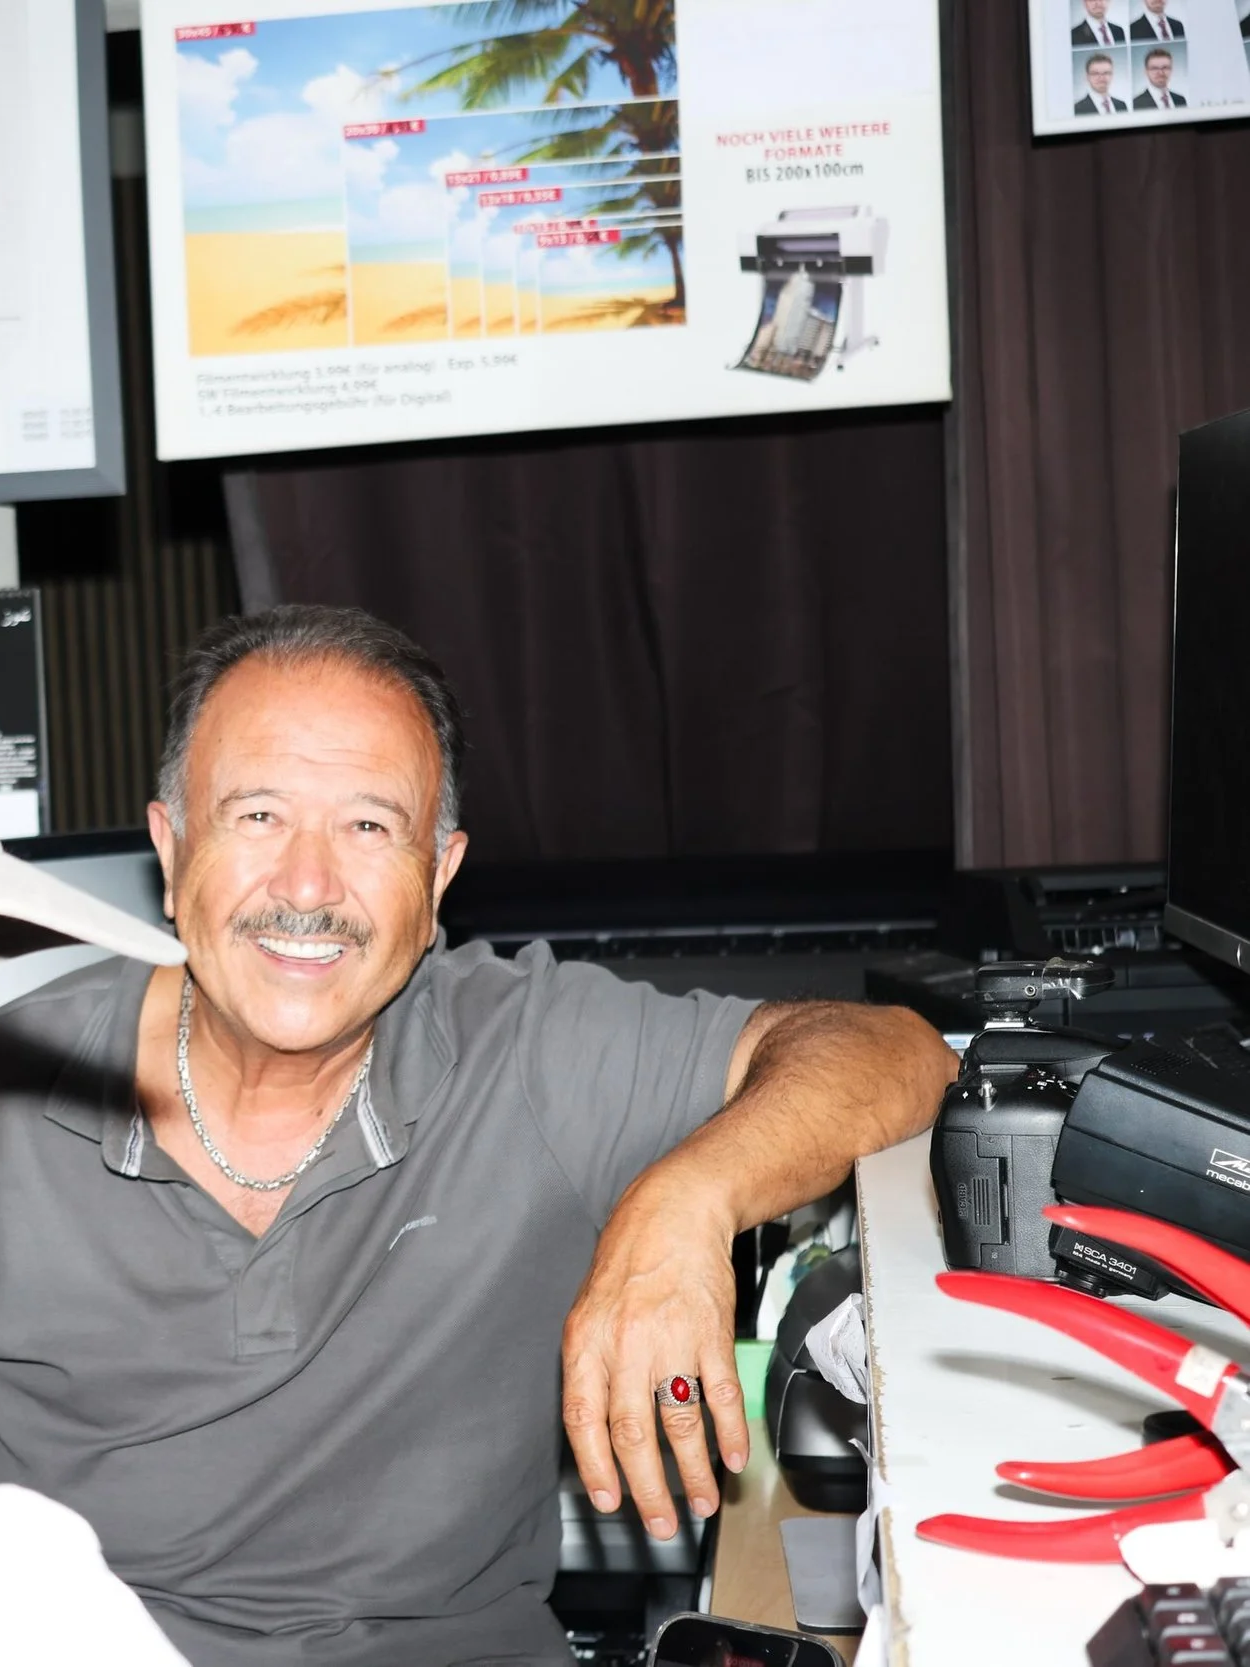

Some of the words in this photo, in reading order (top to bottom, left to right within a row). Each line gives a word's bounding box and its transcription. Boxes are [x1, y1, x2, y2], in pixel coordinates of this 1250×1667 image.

[716, 133, 765, 147] NOCH
[768, 128, 815, 144] VIELE
[819, 122, 891, 140] WEITERE
[763, 143, 844, 162] FORMATE
[745, 167, 771, 184] BIS
[775, 161, 864, 183] 200x100cm
[1206, 1168, 1250, 1191] mecab
[1083, 1246, 1107, 1262] SCA
[1108, 1257, 1137, 1275] 3401
[1084, 1256, 1101, 1266] made
[1108, 1267, 1134, 1280] germany
